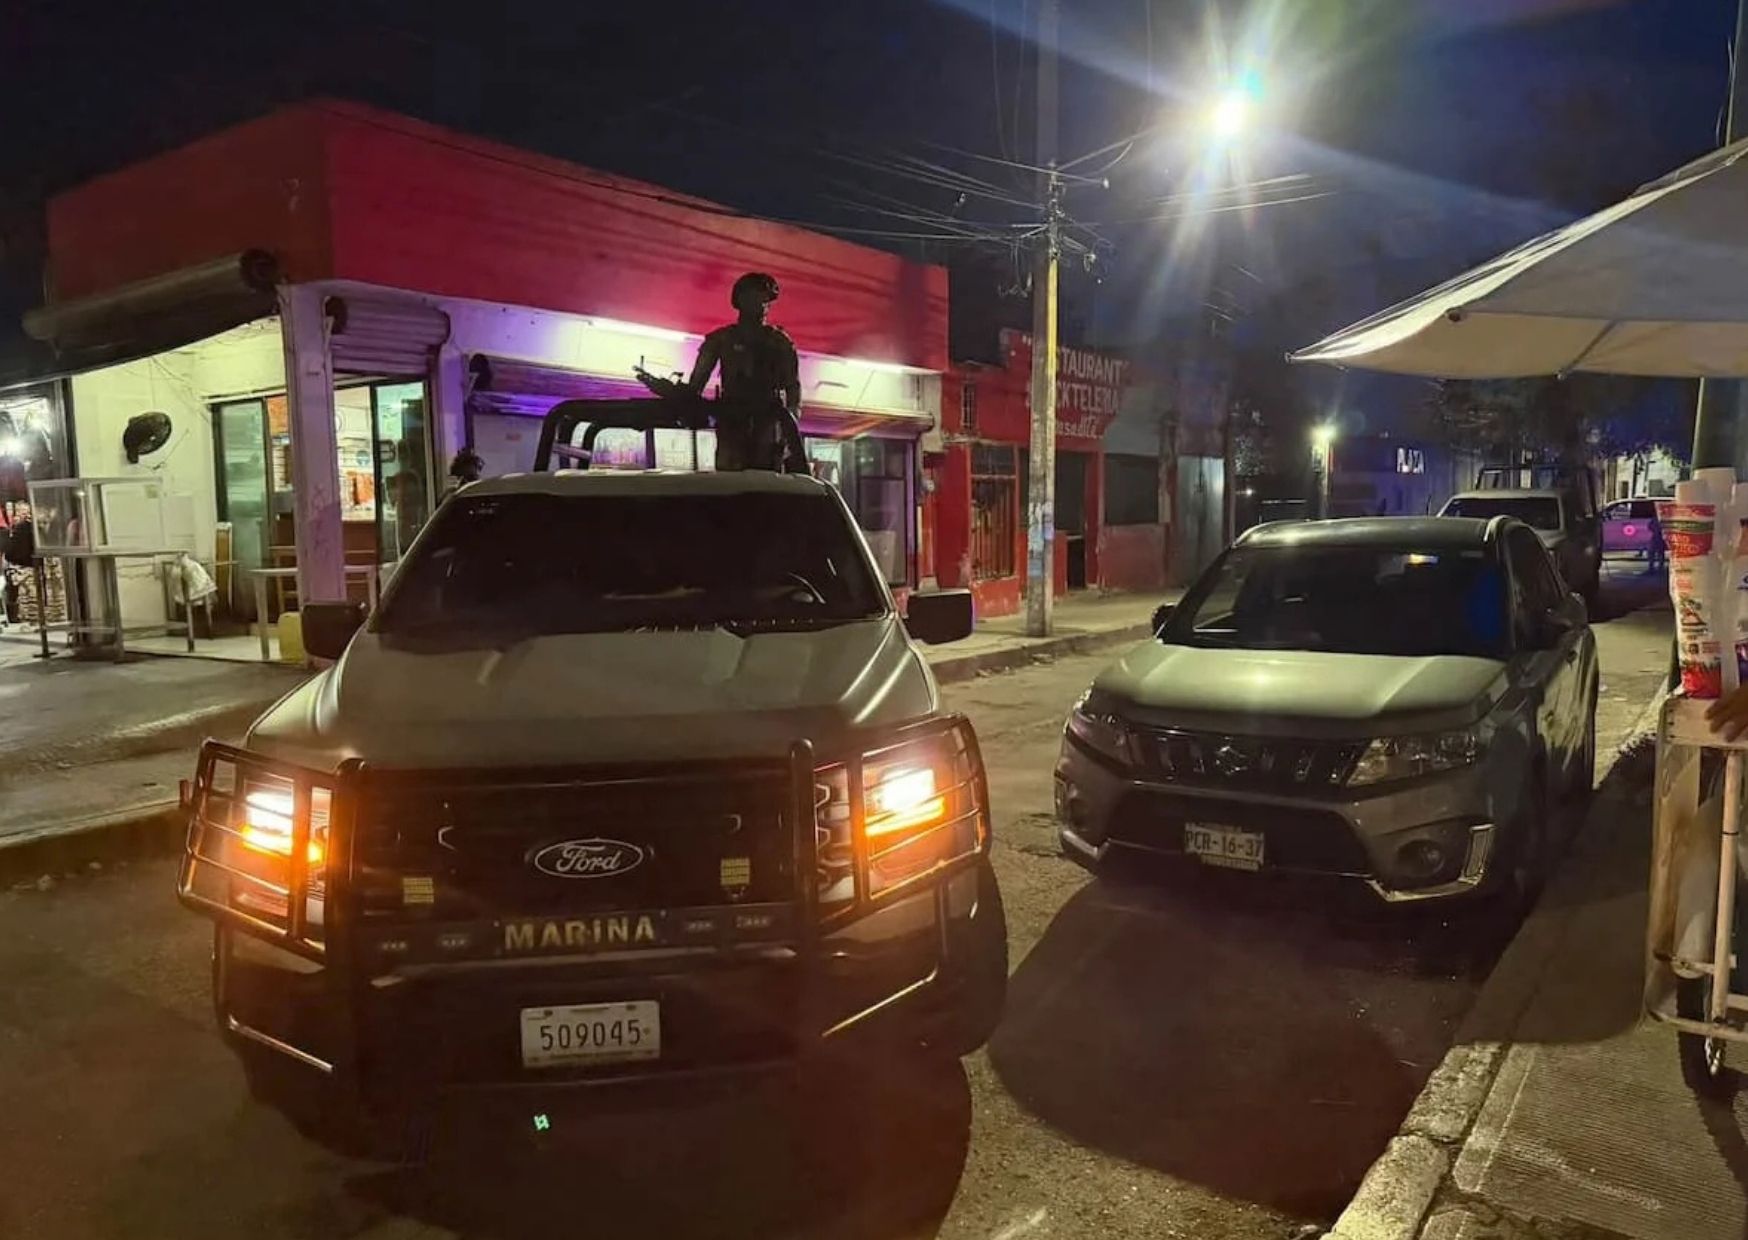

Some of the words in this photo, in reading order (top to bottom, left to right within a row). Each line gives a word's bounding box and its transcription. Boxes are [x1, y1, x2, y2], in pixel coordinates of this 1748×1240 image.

[1397, 448, 1425, 474] PLAZA
[556, 844, 622, 872] Ford
[504, 914, 655, 950] MARINA
[540, 1019, 641, 1051] 509045
